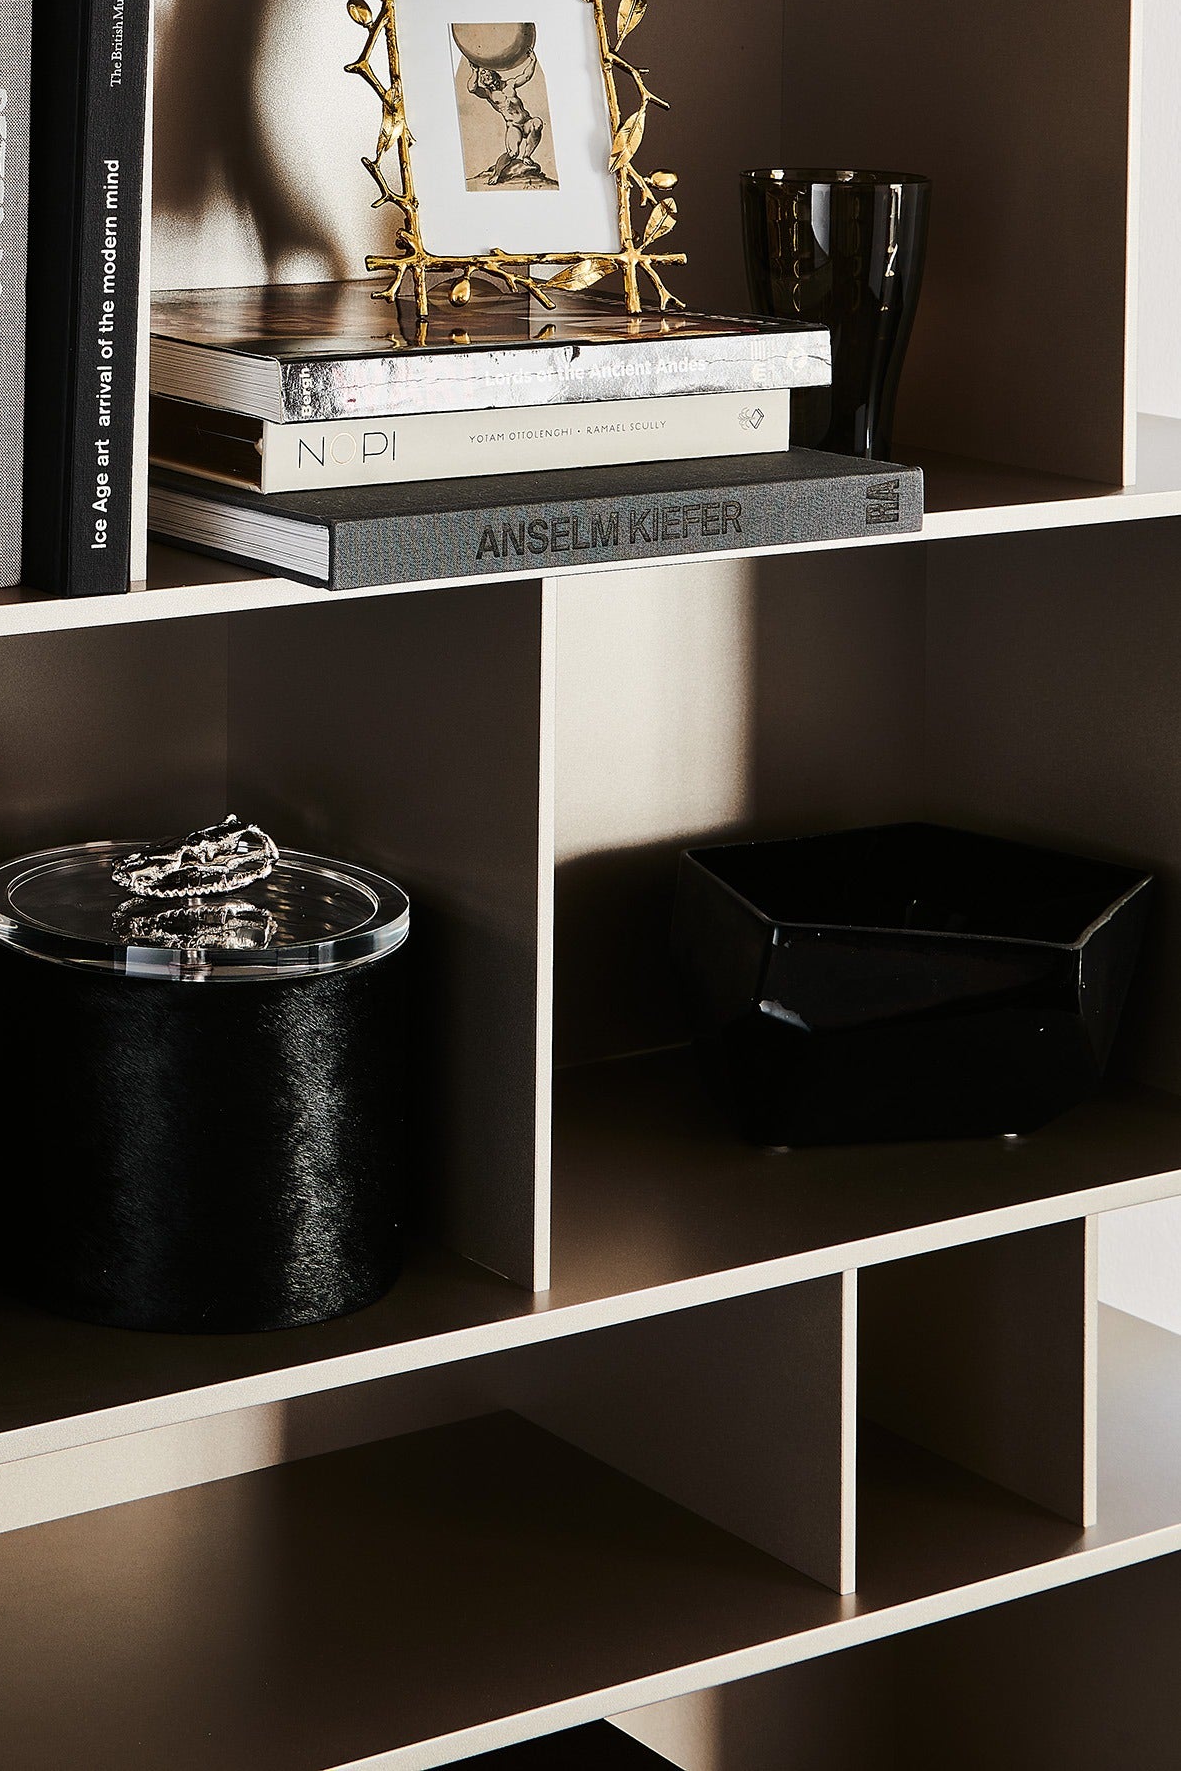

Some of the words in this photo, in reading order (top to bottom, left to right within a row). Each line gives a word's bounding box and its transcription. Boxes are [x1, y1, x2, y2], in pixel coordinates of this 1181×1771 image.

[110, 21, 124, 61] British
[109, 61, 122, 88] The
[103, 159, 119, 209] mind
[101, 216, 117, 294] modern
[99, 300, 115, 333] the
[97, 339, 113, 360] of
[558, 365, 585, 382] the
[589, 360, 652, 379] Ancient
[656, 357, 707, 374] Andes
[95, 366, 112, 427] arrival
[298, 431, 397, 468] NOPI
[469, 432, 506, 444] YOTAM
[508, 428, 573, 441] OTTOLENGHI
[586, 424, 627, 435] RAMAEL
[629, 420, 667, 432] SCULLY
[94, 438, 110, 467] art
[91, 472, 111, 514] Age
[91, 518, 107, 549] Ice
[475, 510, 620, 560] ANSELM
[628, 500, 743, 545] KIEFER
